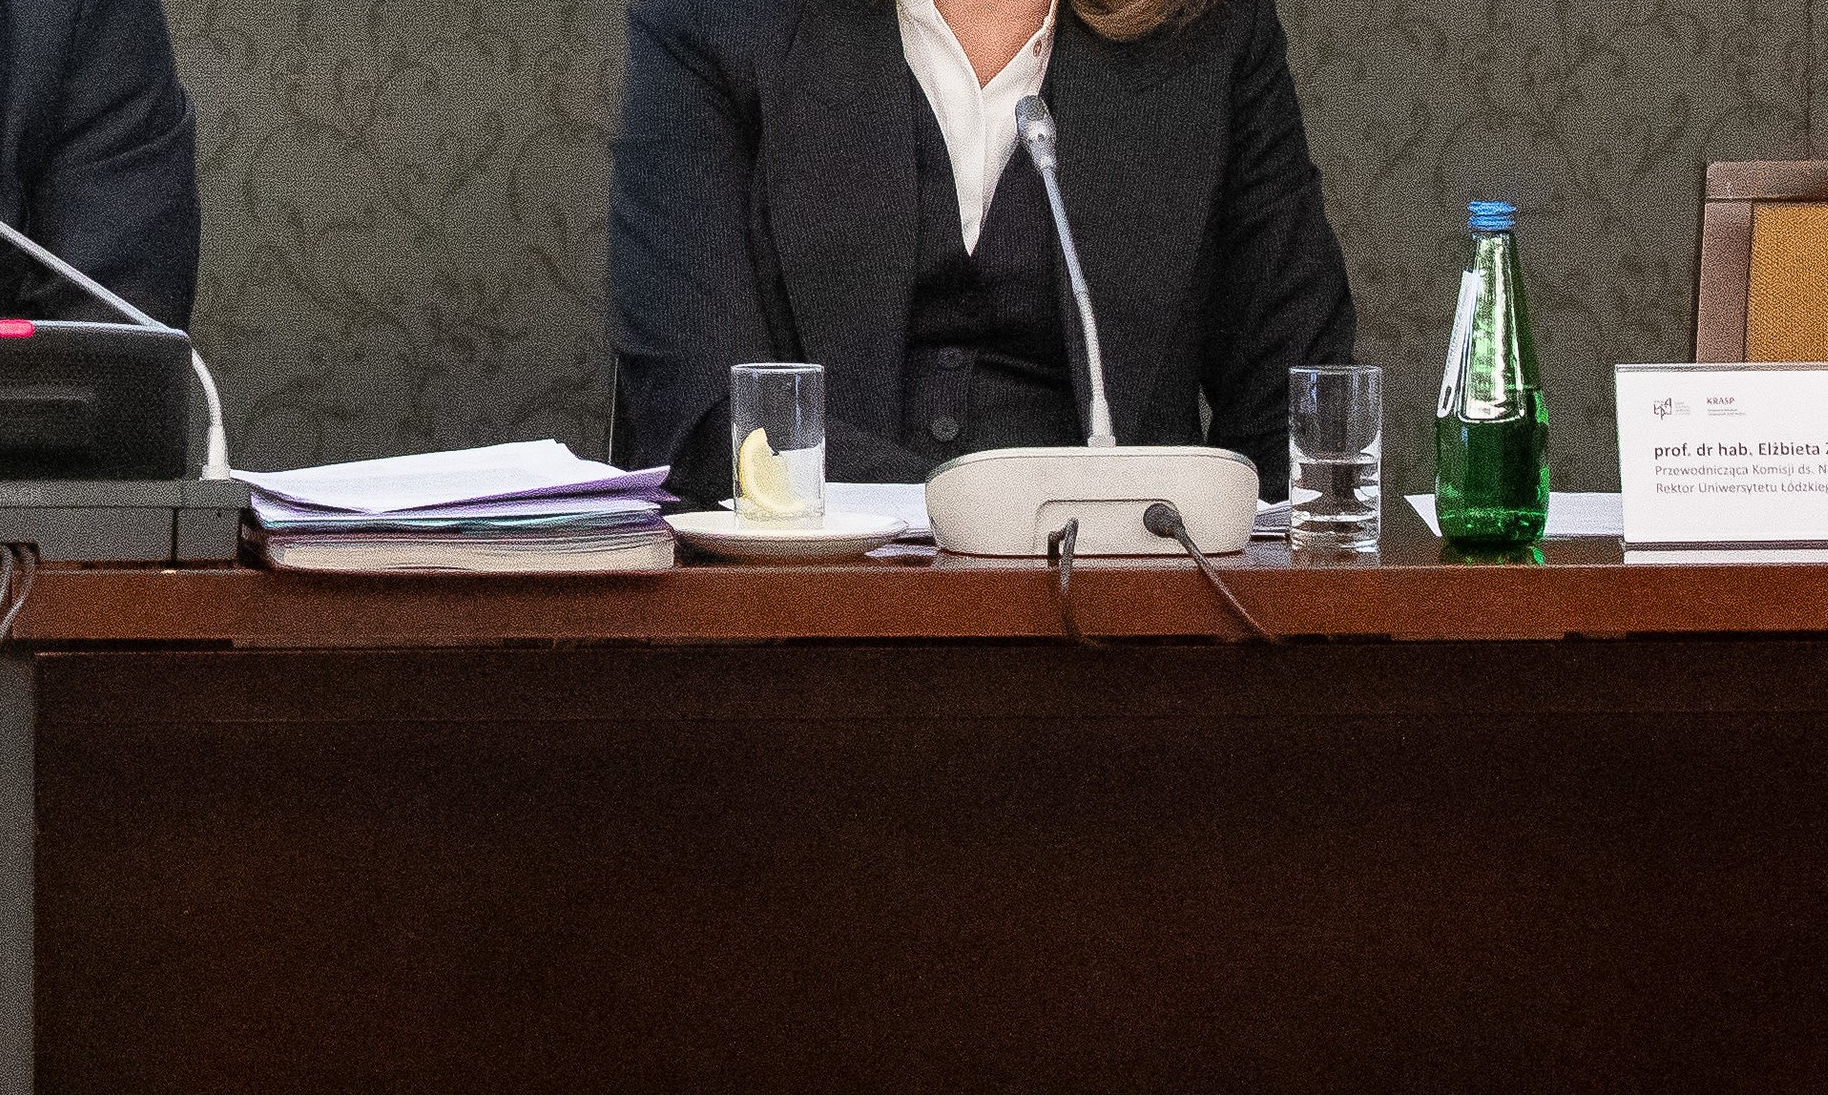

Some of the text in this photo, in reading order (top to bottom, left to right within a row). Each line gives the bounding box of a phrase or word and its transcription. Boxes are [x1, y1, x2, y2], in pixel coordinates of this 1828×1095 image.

[1706, 397, 1735, 405] KRASP
[1655, 443, 1690, 460] prof.
[1697, 443, 1713, 456] dr
[1718, 442, 1752, 456] hab.
[1759, 442, 1820, 455] Elżbieta
[1655, 465, 1748, 477] Przewodnicząca
[1752, 465, 1794, 476] Komisji
[1798, 464, 1813, 474] ds.
[1656, 483, 1694, 494] Rektor
[1699, 483, 1777, 494] Uniwersytetu
